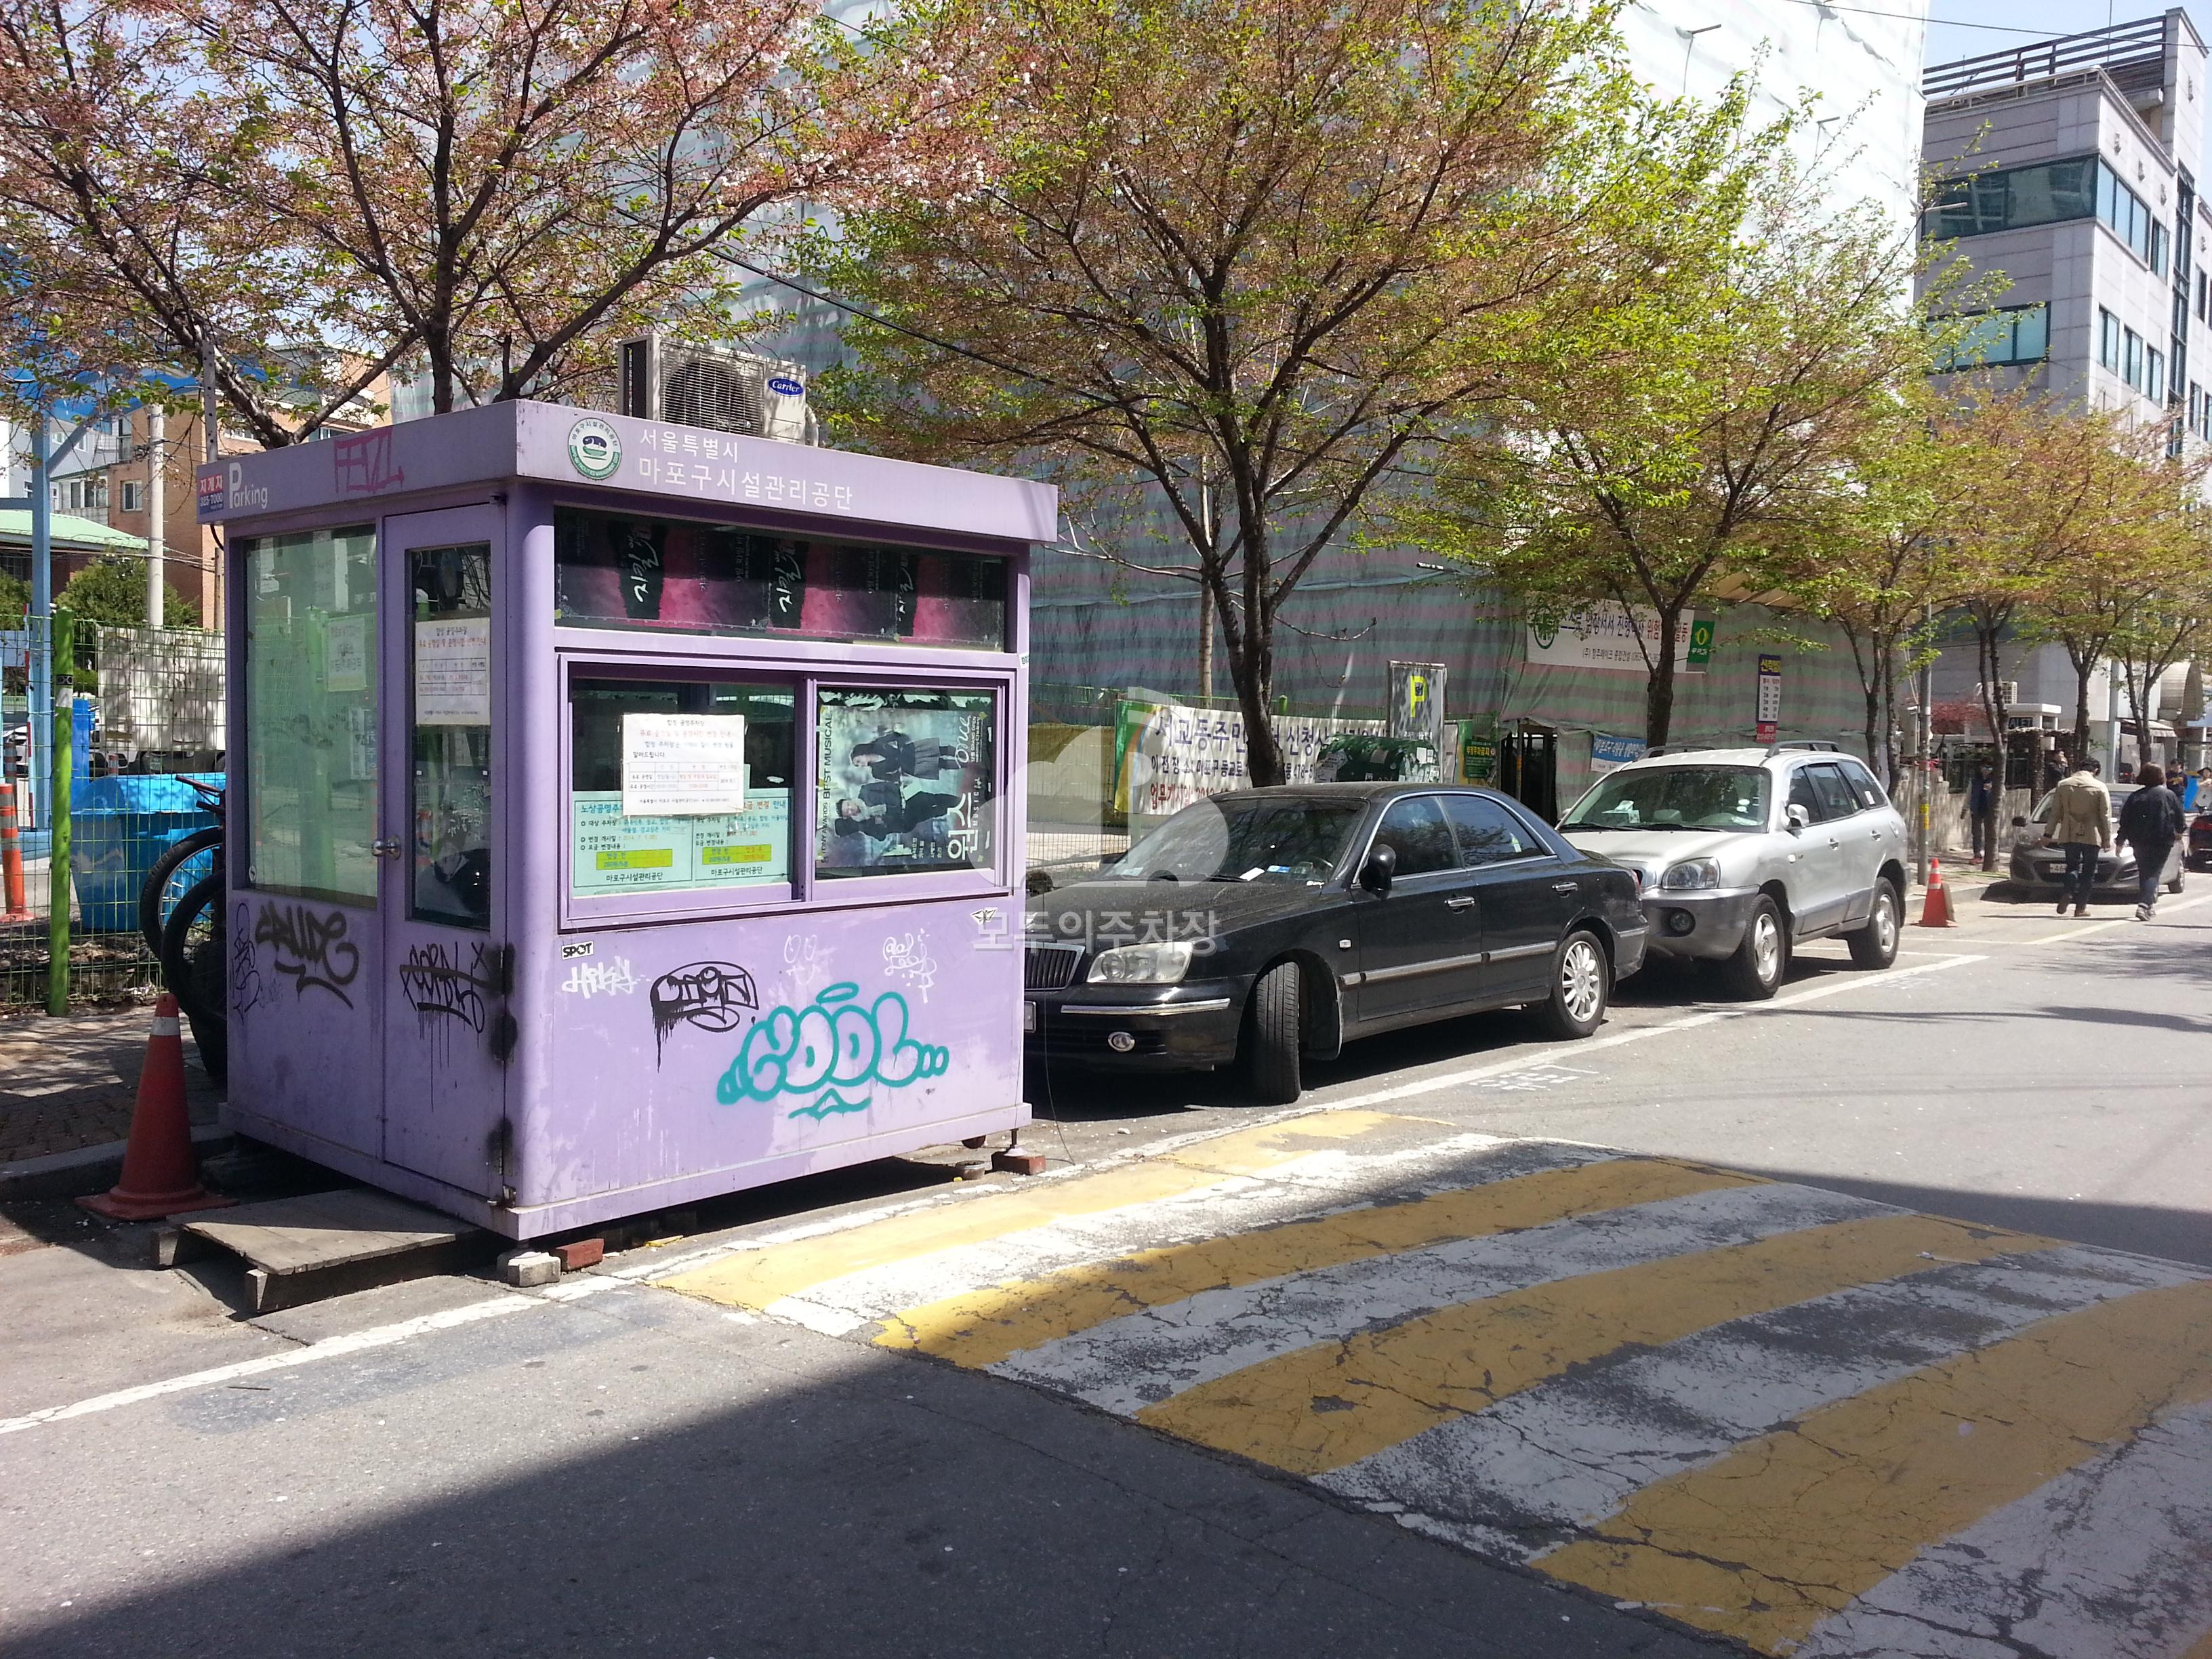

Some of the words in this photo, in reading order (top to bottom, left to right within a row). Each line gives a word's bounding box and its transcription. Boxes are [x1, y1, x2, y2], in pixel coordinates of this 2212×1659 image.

[772, 380, 800, 392] Carrier
[640, 428, 739, 464] 서울특별시
[229, 462, 268, 510] Parking
[638, 455, 854, 512] 마포구시설관리공단
[1410, 674, 1429, 718] P
[823, 714, 832, 766] MUSICAL
[1196, 758, 1218, 777] 마포구
[1221, 760, 1243, 778] 동교로
[581, 803, 623, 814] 노상공영주
[947, 792, 979, 861] 원스
[607, 872, 663, 882] 마포구시설관리공단
[711, 867, 763, 876] 마포구시설관리공단
[562, 941, 593, 958] SPOT
